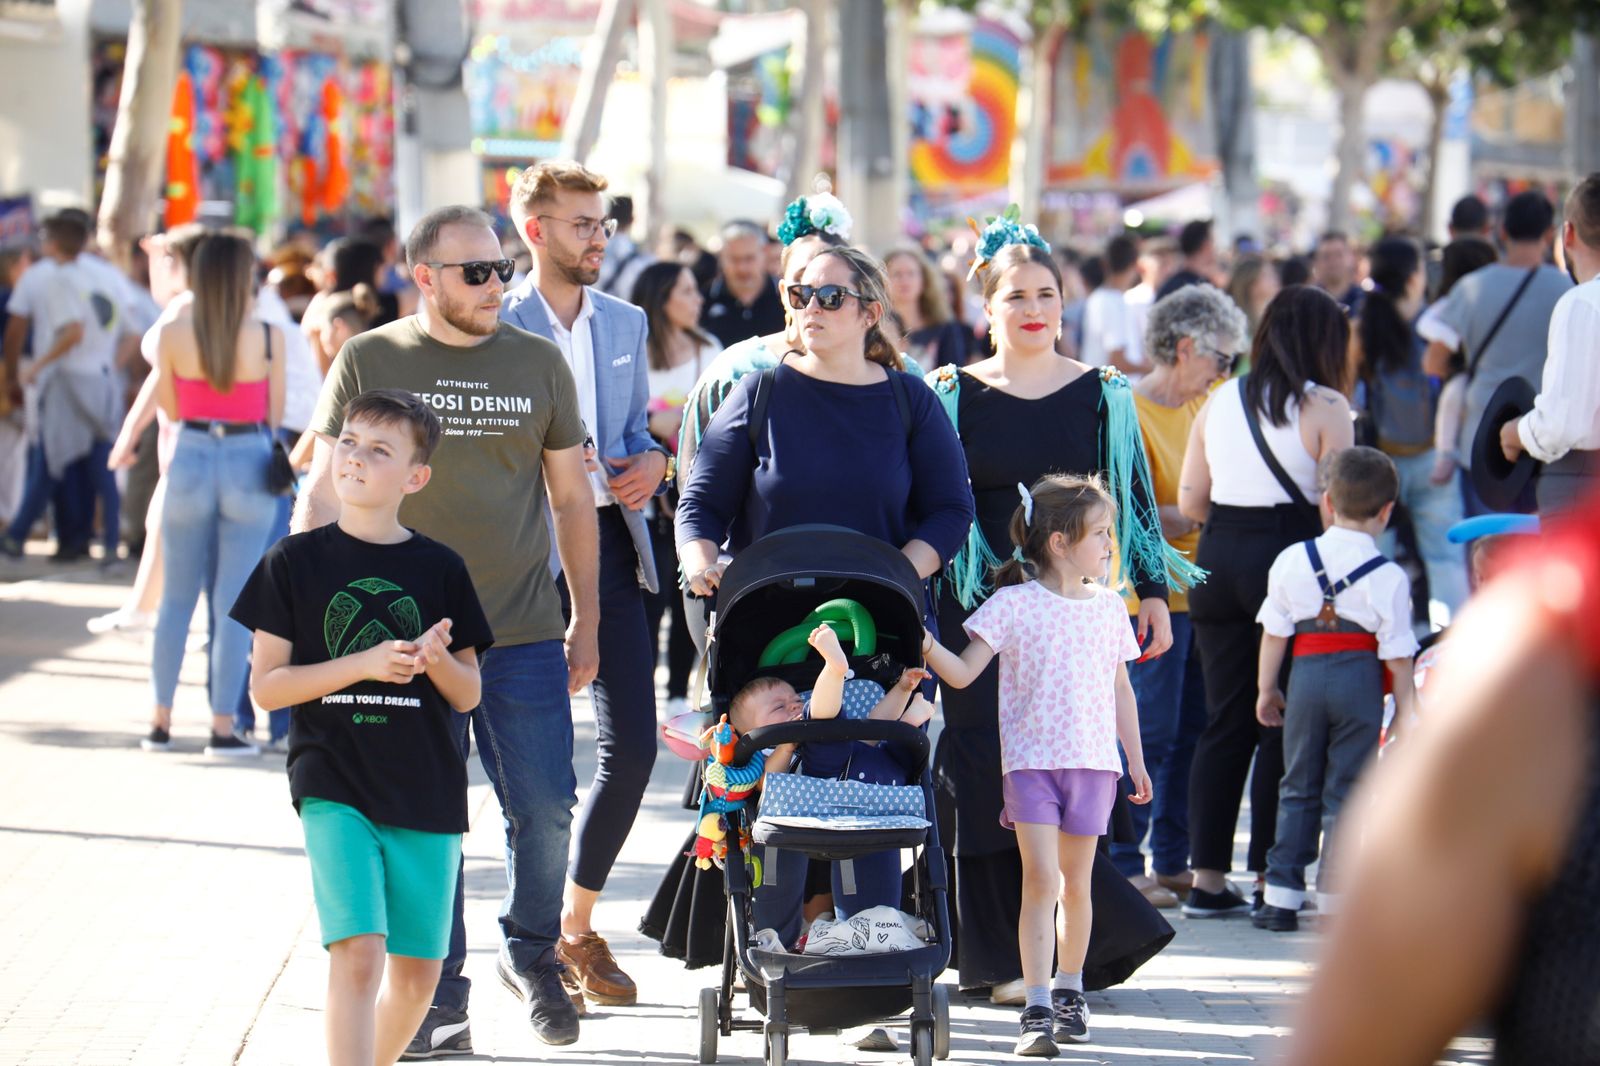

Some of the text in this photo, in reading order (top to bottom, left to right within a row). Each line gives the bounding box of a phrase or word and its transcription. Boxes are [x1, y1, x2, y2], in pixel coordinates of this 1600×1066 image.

[436, 379, 489, 389] AUTHENTIC
[411, 392, 532, 414] FOSI DENIM
[447, 416, 472, 425] YOUR
[476, 418, 520, 427] ATTITUDE
[444, 428, 464, 436] Since
[322, 694, 421, 707] POWER YOUR DREAMS
[363, 715, 388, 724] XBOX
